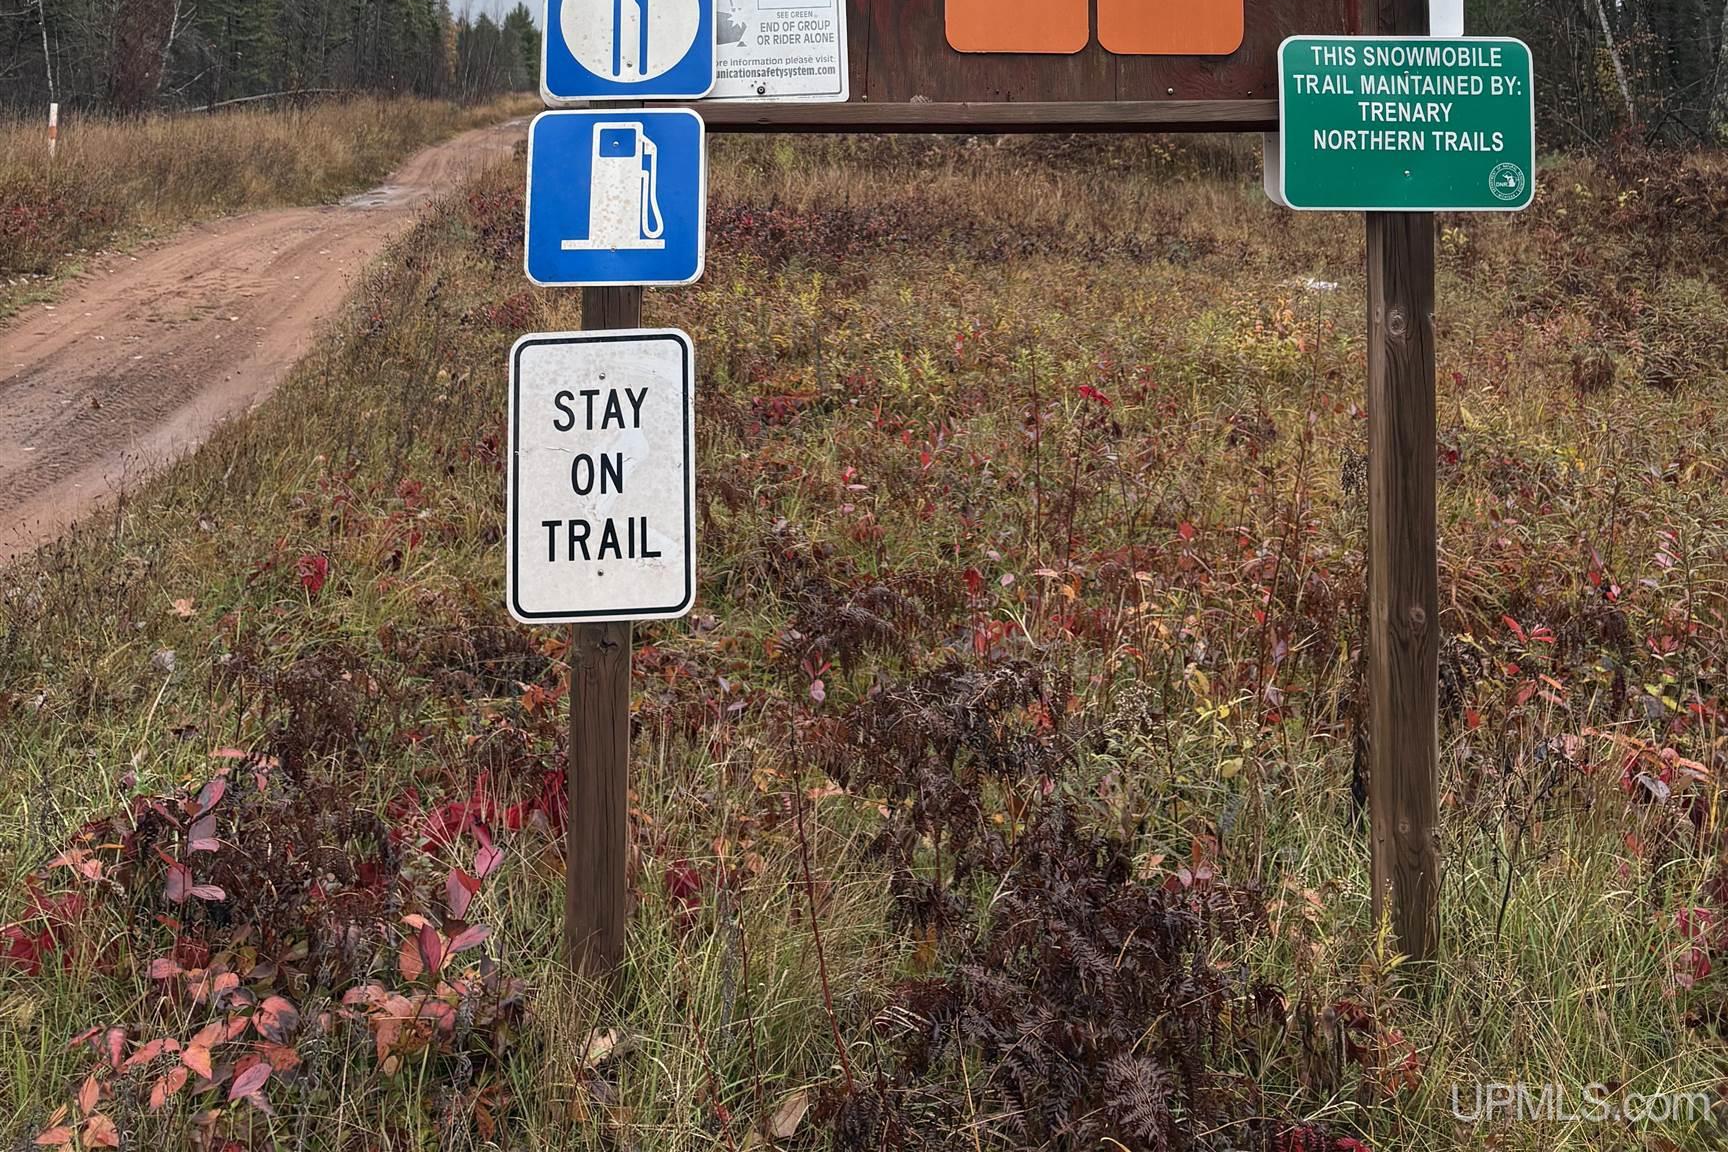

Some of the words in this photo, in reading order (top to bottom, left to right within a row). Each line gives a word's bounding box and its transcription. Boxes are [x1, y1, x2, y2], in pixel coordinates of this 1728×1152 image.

[760, 22, 780, 32] END
[782, 21, 795, 32] OF
[798, 20, 831, 30] GROUP
[756, 35, 770, 45] OR
[773, 34, 801, 44] RIDER
[804, 32, 834, 43] ALONE
[730, 57, 783, 66] information
[786, 56, 814, 65] please
[1311, 46, 1357, 66] THIS
[1363, 47, 1502, 67] SNOWMOBILE
[1293, 74, 1354, 94] TRAIL
[1360, 75, 1483, 95] MAINTAINED
[1491, 76, 1522, 96] BY:
[1358, 102, 1453, 123] TRENARY
[1313, 130, 1425, 151] NORTHERN
[1431, 131, 1504, 152] TRAILS
[553, 387, 648, 432] STAY
[571, 452, 623, 496] ON
[542, 516, 662, 562] TRAIL
